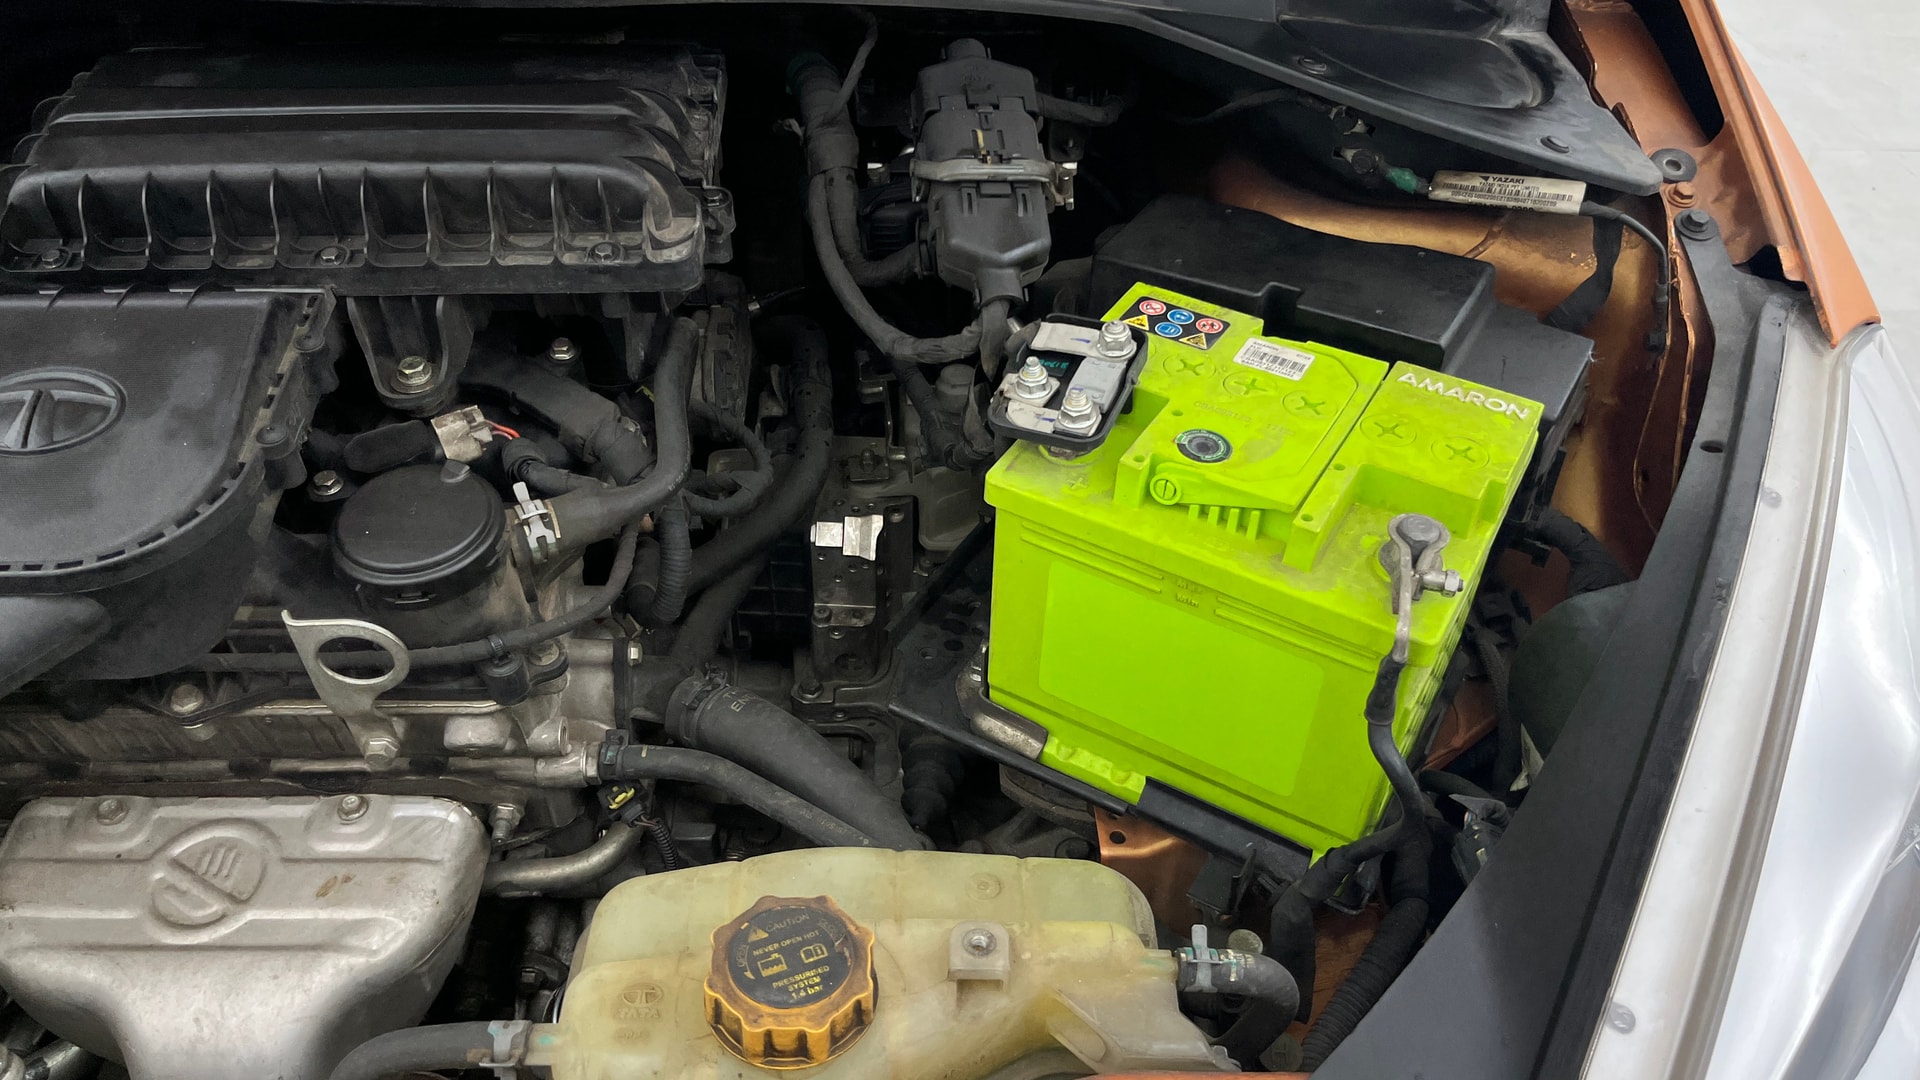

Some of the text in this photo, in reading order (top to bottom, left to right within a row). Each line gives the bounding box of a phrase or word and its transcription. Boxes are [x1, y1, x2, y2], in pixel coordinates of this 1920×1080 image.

[1491, 176, 1525, 185] YAZAKI
[1397, 372, 1530, 421] AMARON
[766, 912, 811, 932] CAUTION
[753, 929, 820, 957] NEVER OPEN HOT
[772, 965, 830, 989] PRESSURISED
[788, 975, 822, 992] SYSTEM
[806, 984, 823, 995] bar
